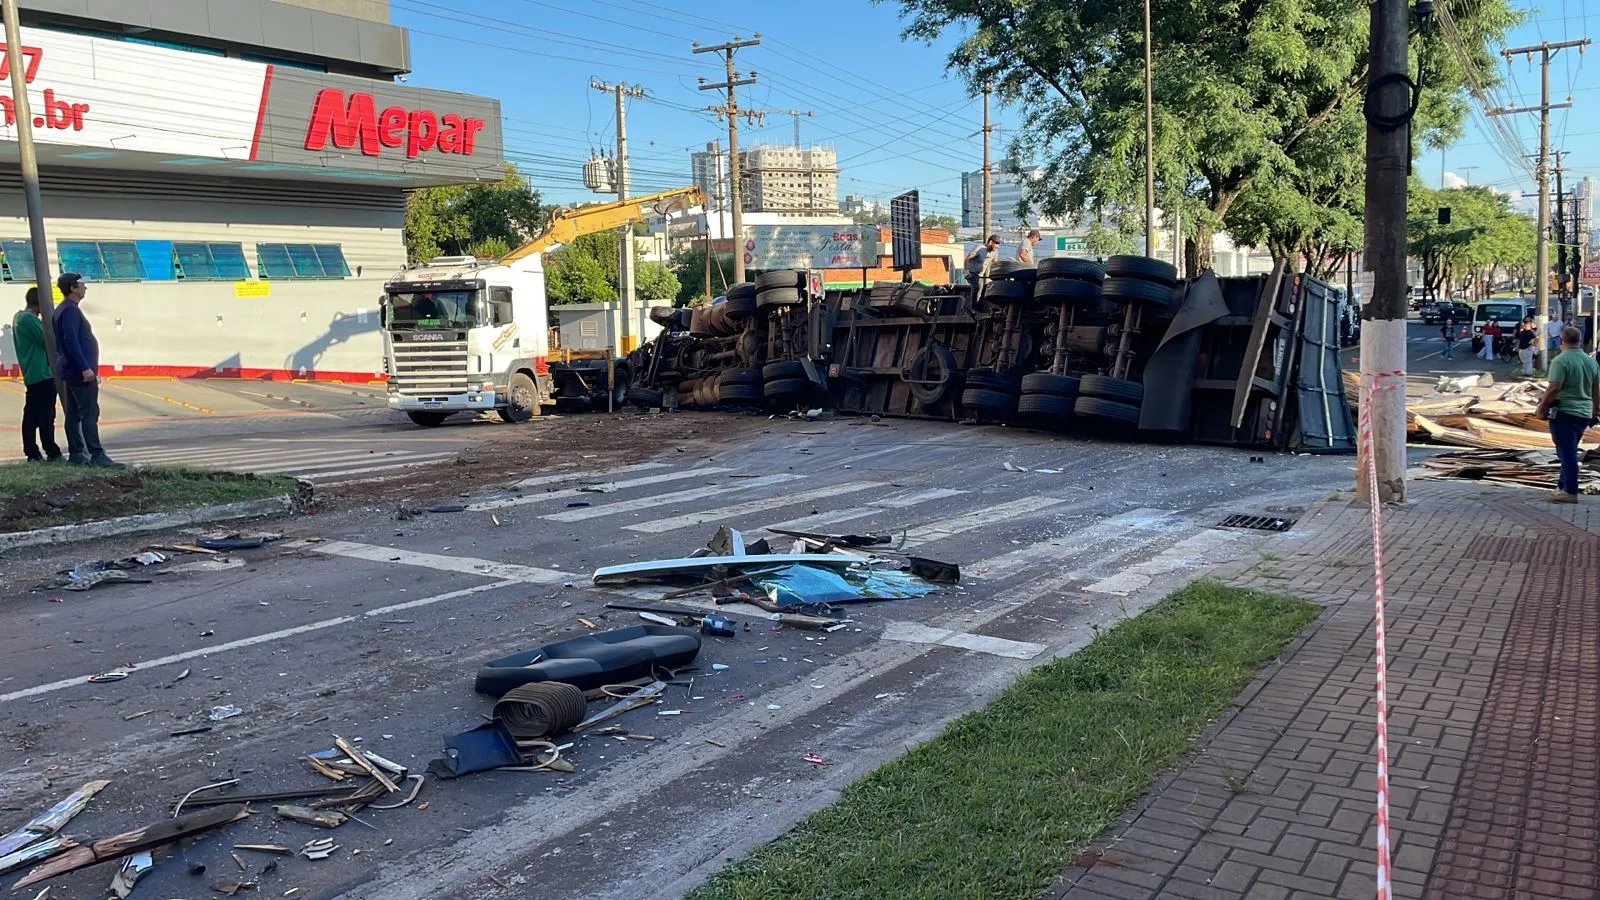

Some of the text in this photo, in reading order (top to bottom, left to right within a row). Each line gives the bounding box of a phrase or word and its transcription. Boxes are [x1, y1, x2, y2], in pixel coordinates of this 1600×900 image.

[304, 88, 486, 159] Mepar
[832, 232, 858, 241] Boas
[412, 333, 444, 341] SCANIA
